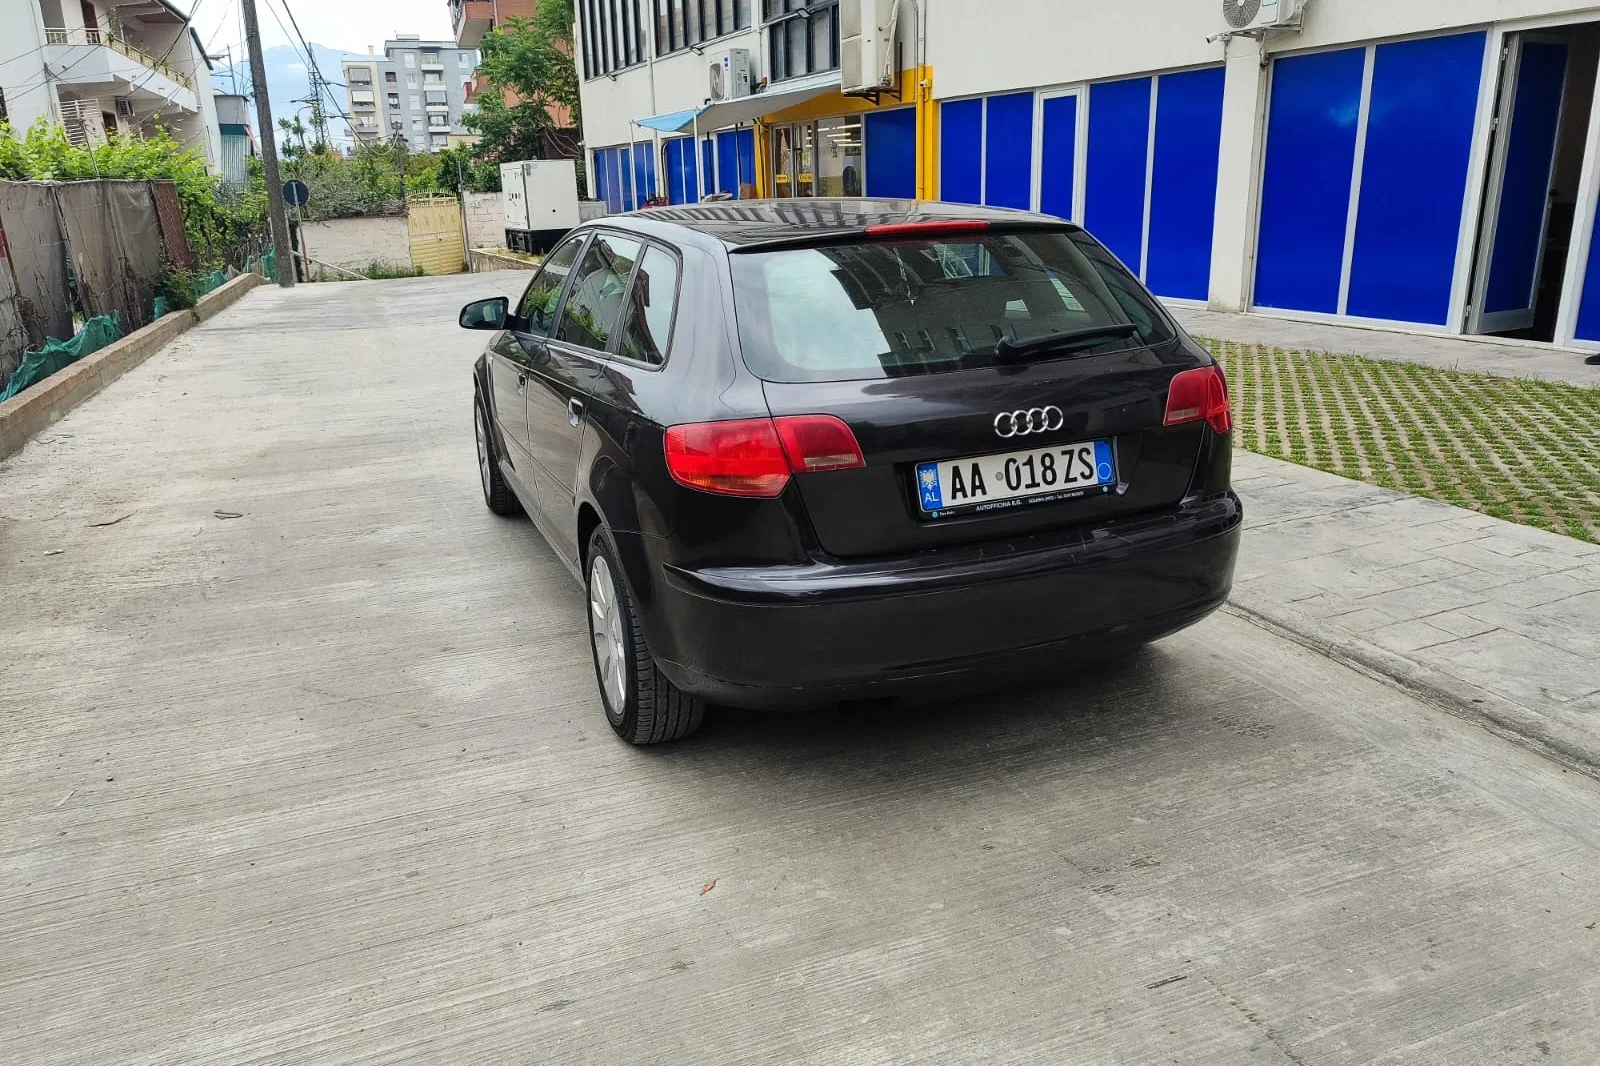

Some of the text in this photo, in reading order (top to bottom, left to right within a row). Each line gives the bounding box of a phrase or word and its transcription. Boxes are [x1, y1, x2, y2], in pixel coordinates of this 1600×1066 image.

[951, 447, 1095, 500] AA 018 ZS
[924, 491, 940, 503] AL
